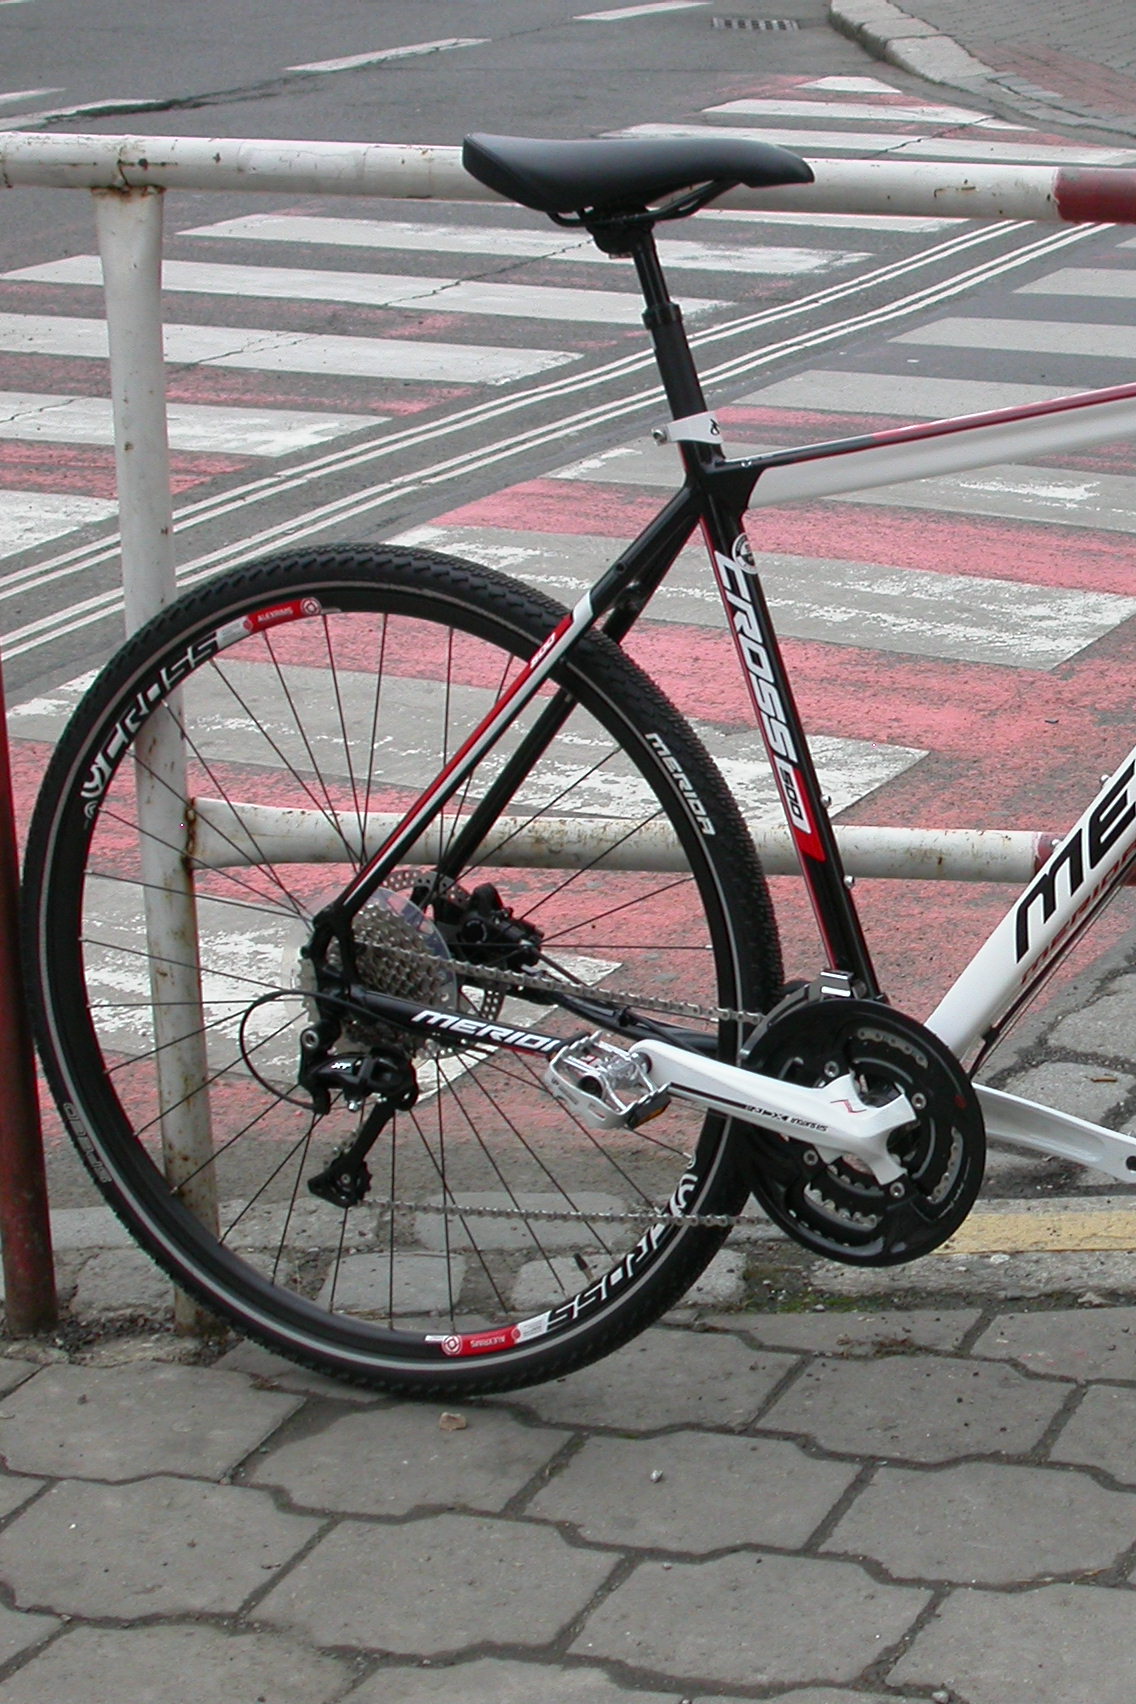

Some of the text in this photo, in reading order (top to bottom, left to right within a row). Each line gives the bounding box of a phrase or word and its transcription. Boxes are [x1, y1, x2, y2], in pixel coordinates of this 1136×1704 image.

[714, 550, 798, 764] CROSS
[645, 732, 716, 836] MERIDA
[776, 766, 804, 820] 500
